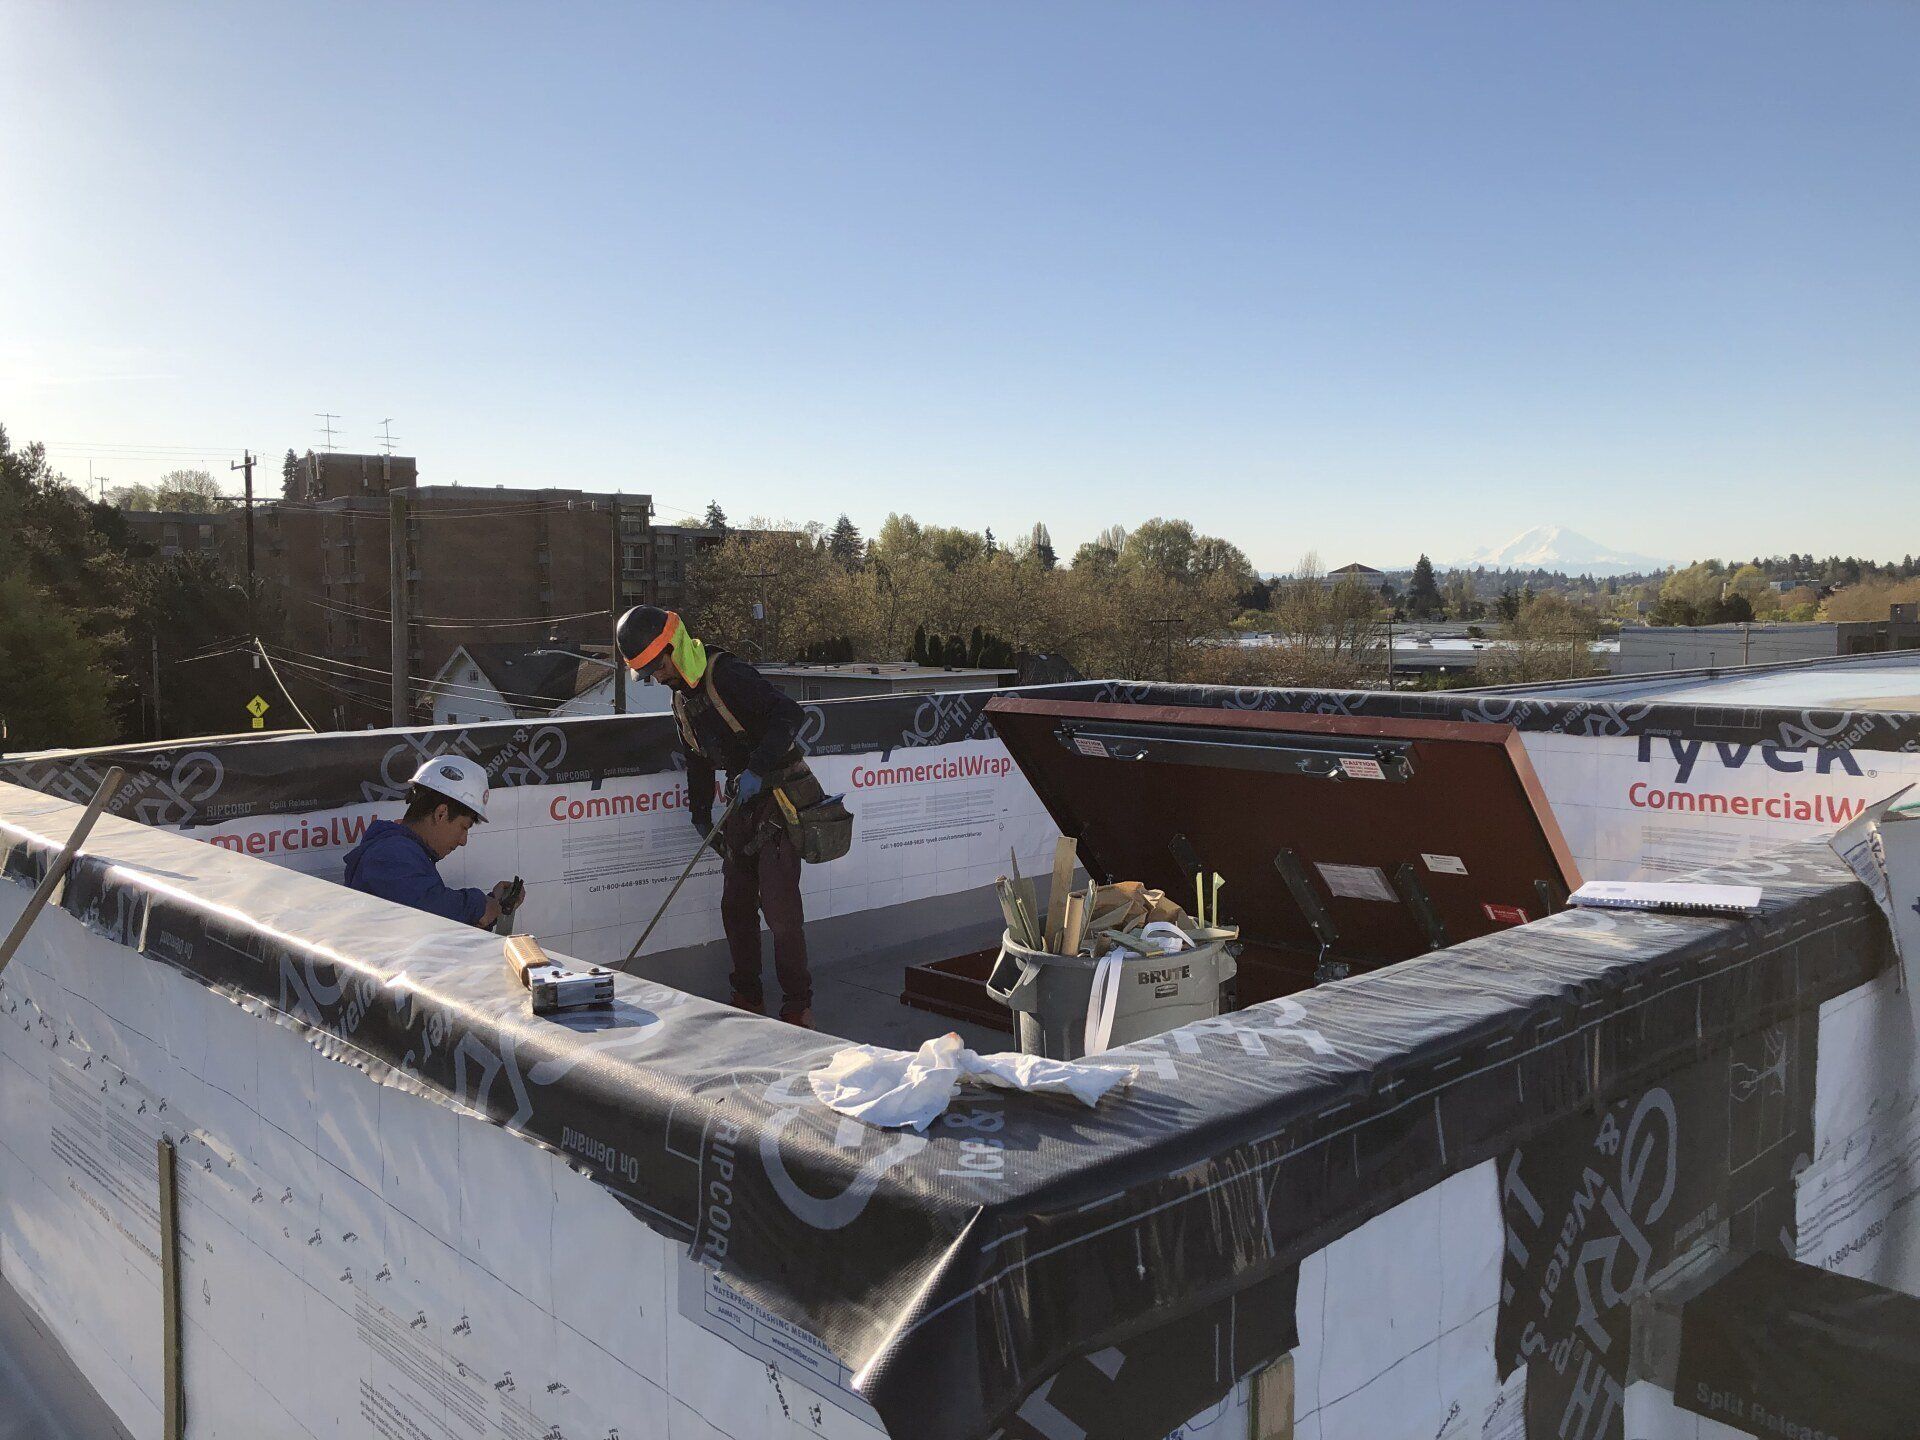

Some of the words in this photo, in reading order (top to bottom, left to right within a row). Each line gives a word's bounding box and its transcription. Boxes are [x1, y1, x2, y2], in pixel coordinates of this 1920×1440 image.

[1826, 716, 1876, 750] hield
[486, 743, 519, 778] Wate
[852, 755, 1011, 788] CommercialWrap
[104, 769, 158, 813] Wate
[287, 798, 318, 808] Release
[1629, 782, 1866, 823] CommercialW
[203, 814, 379, 854] mercialW
[589, 885, 601, 893] Call
[1138, 964, 1190, 985] BRUTE
[560, 1126, 616, 1173] Demand
[620, 1149, 639, 1184] On
[712, 1284, 754, 1313] WATERPROOF
[755, 1306, 790, 1331] FLASHING
[494, 1376, 515, 1392] Tyvek
